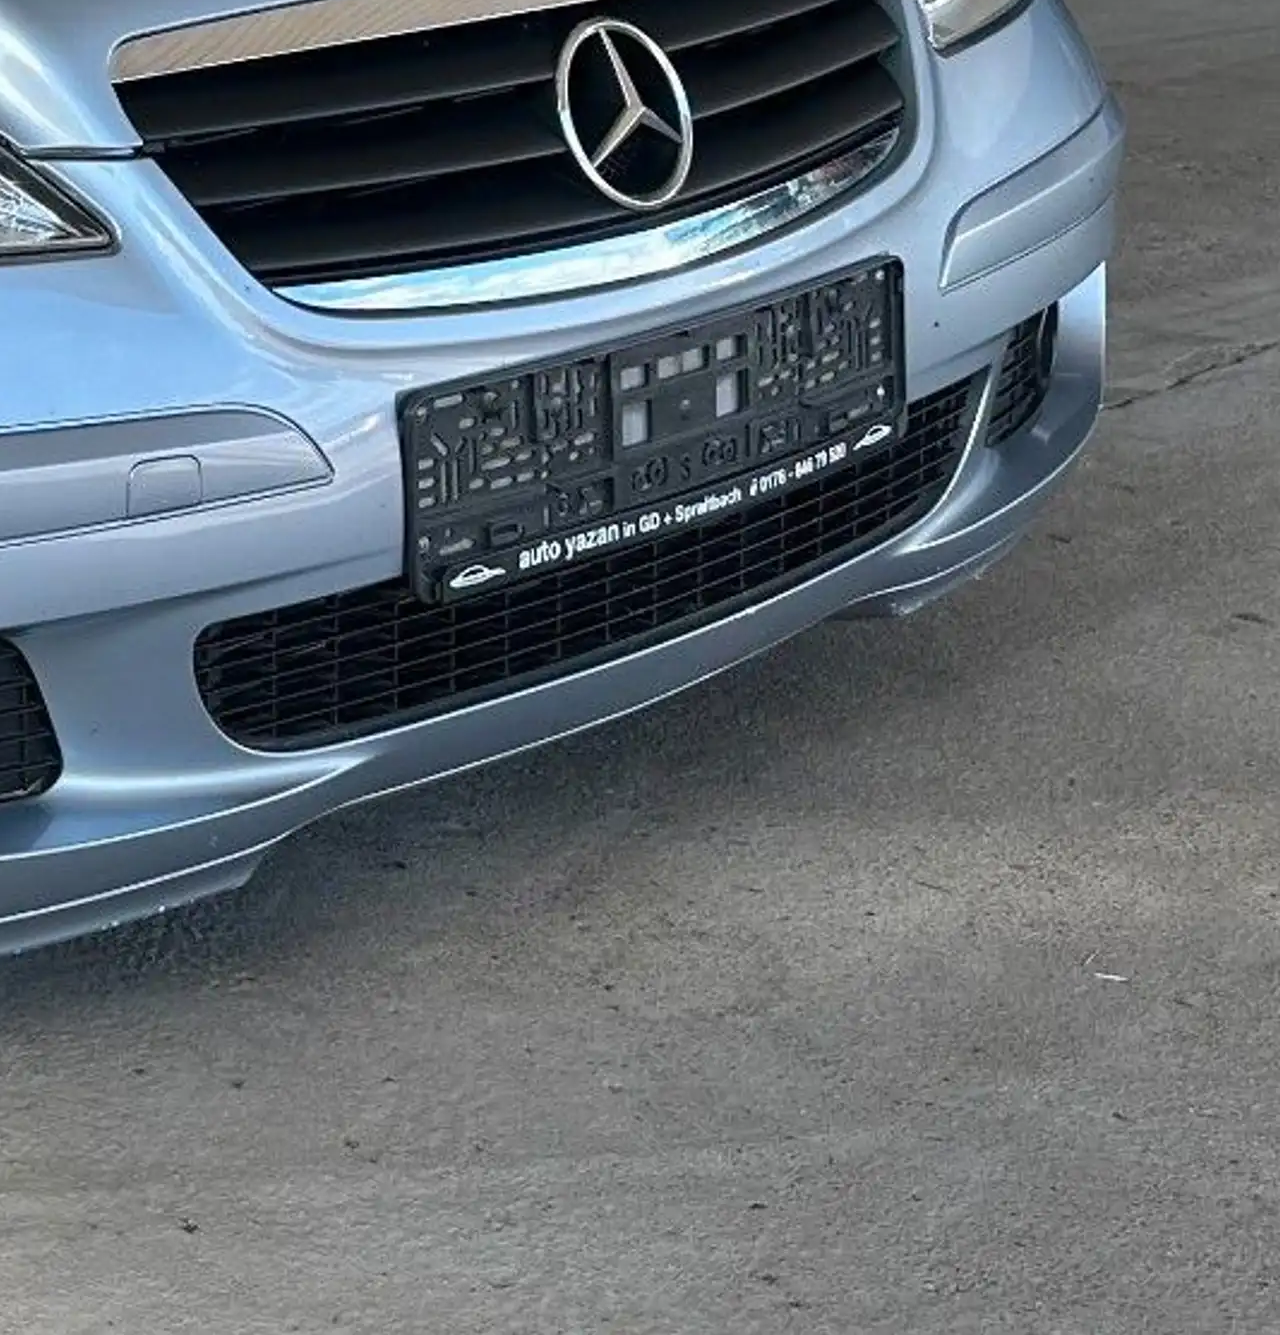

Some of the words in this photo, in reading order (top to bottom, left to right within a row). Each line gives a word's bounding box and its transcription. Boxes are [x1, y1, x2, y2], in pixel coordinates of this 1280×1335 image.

[519, 540, 561, 570] auto
[564, 524, 620, 561] yazan
[622, 521, 636, 539] in
[639, 511, 660, 534] GD
